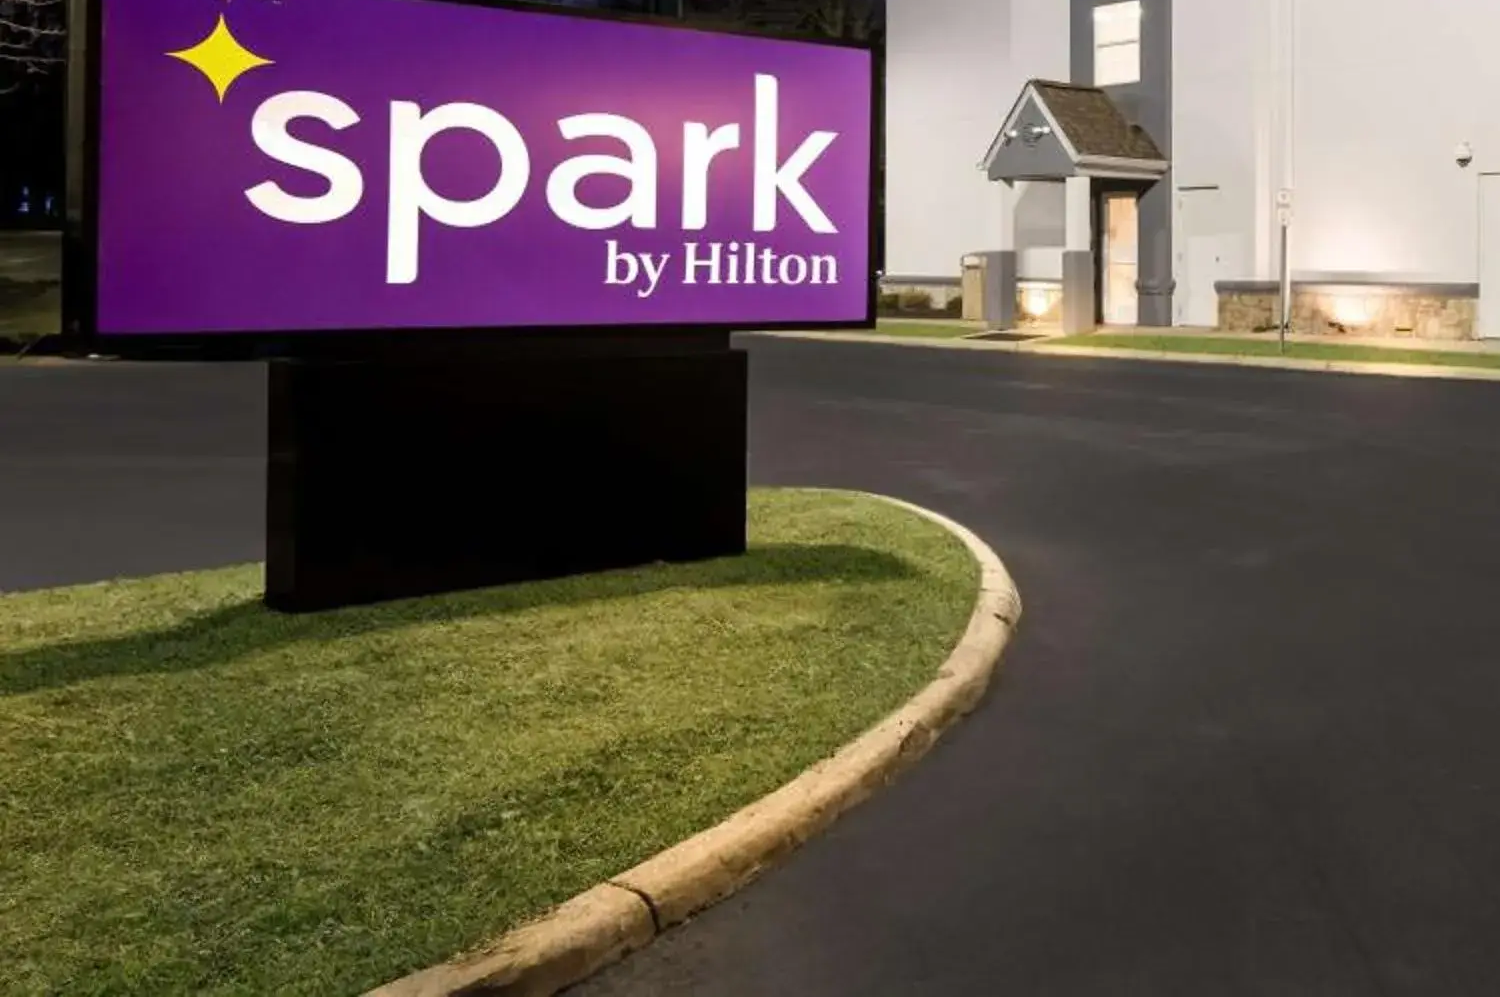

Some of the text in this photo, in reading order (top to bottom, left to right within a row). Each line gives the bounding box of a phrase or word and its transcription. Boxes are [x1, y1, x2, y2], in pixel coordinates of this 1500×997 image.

[245, 73, 839, 284] spark
[604, 240, 838, 298] by Hilton
